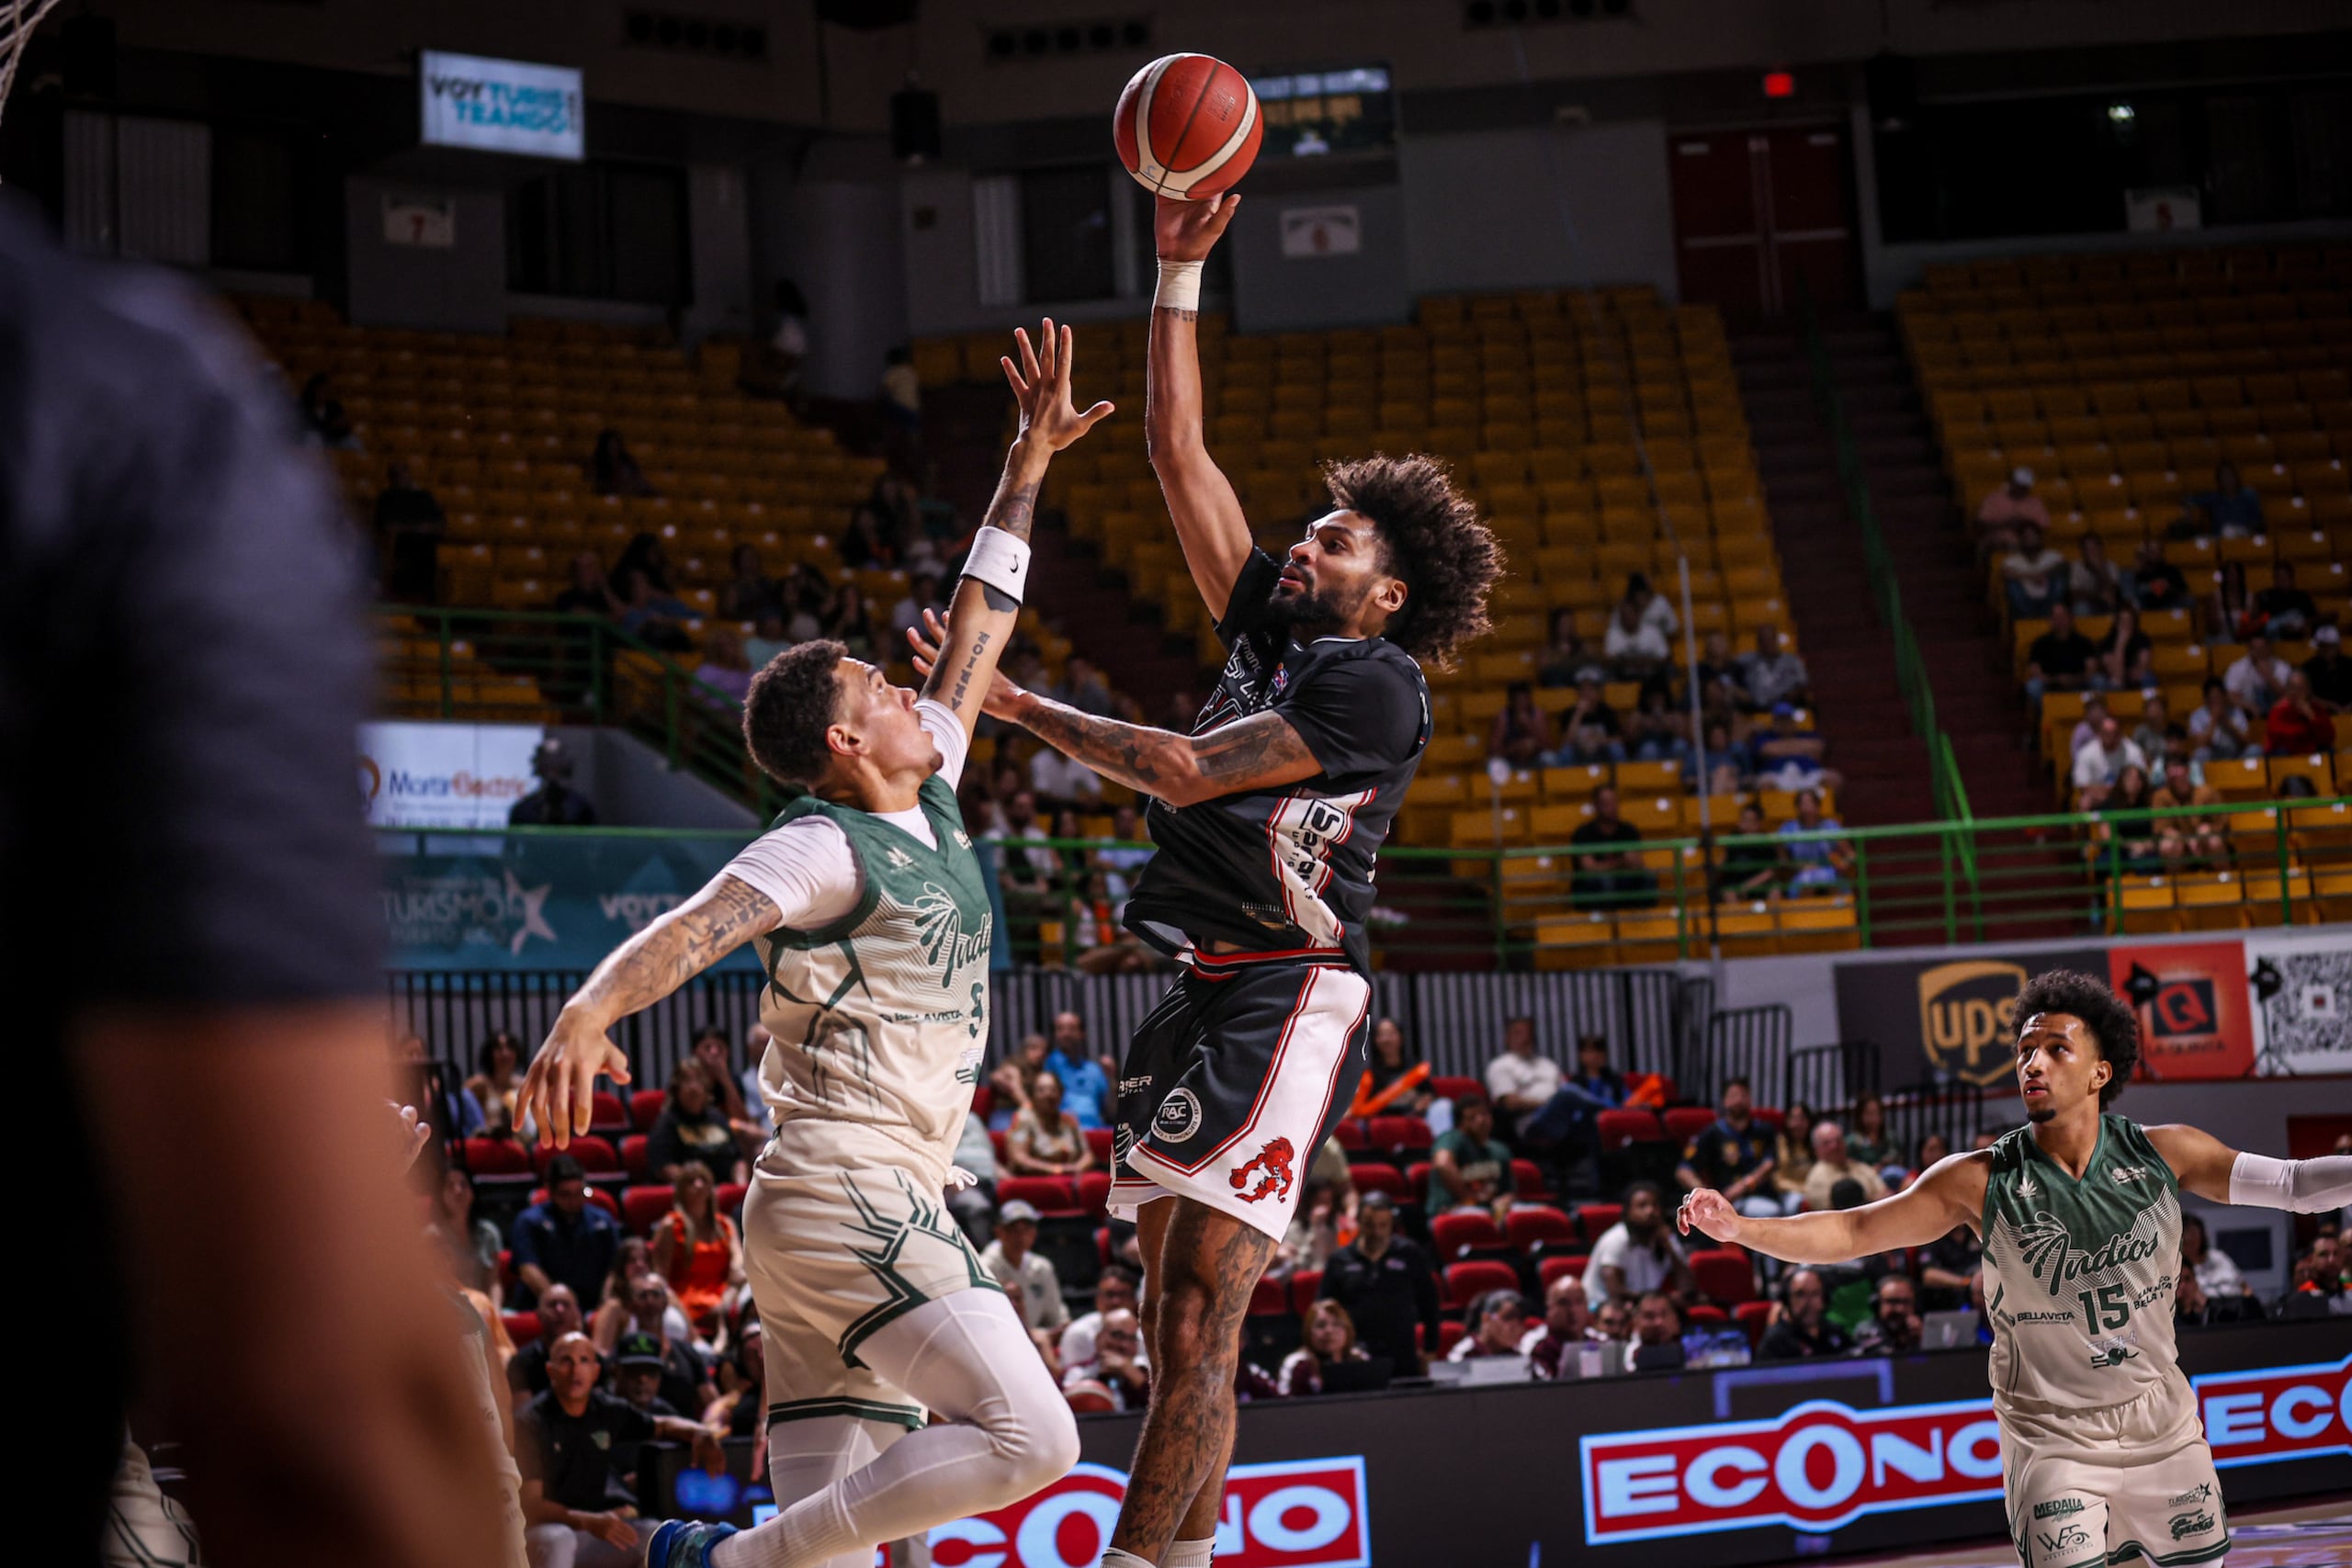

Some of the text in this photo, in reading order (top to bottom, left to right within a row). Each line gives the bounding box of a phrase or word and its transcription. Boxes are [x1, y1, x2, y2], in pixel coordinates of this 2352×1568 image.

[1931, 998, 2016, 1066] ups
[2034, 1222, 2161, 1296] Indios
[2017, 1311, 2075, 1322] BELLAVISTA
[2078, 1282, 2131, 1335] 15
[1597, 1424, 2001, 1511] ECONO
[2033, 1498, 2084, 1517] MEDALLA
